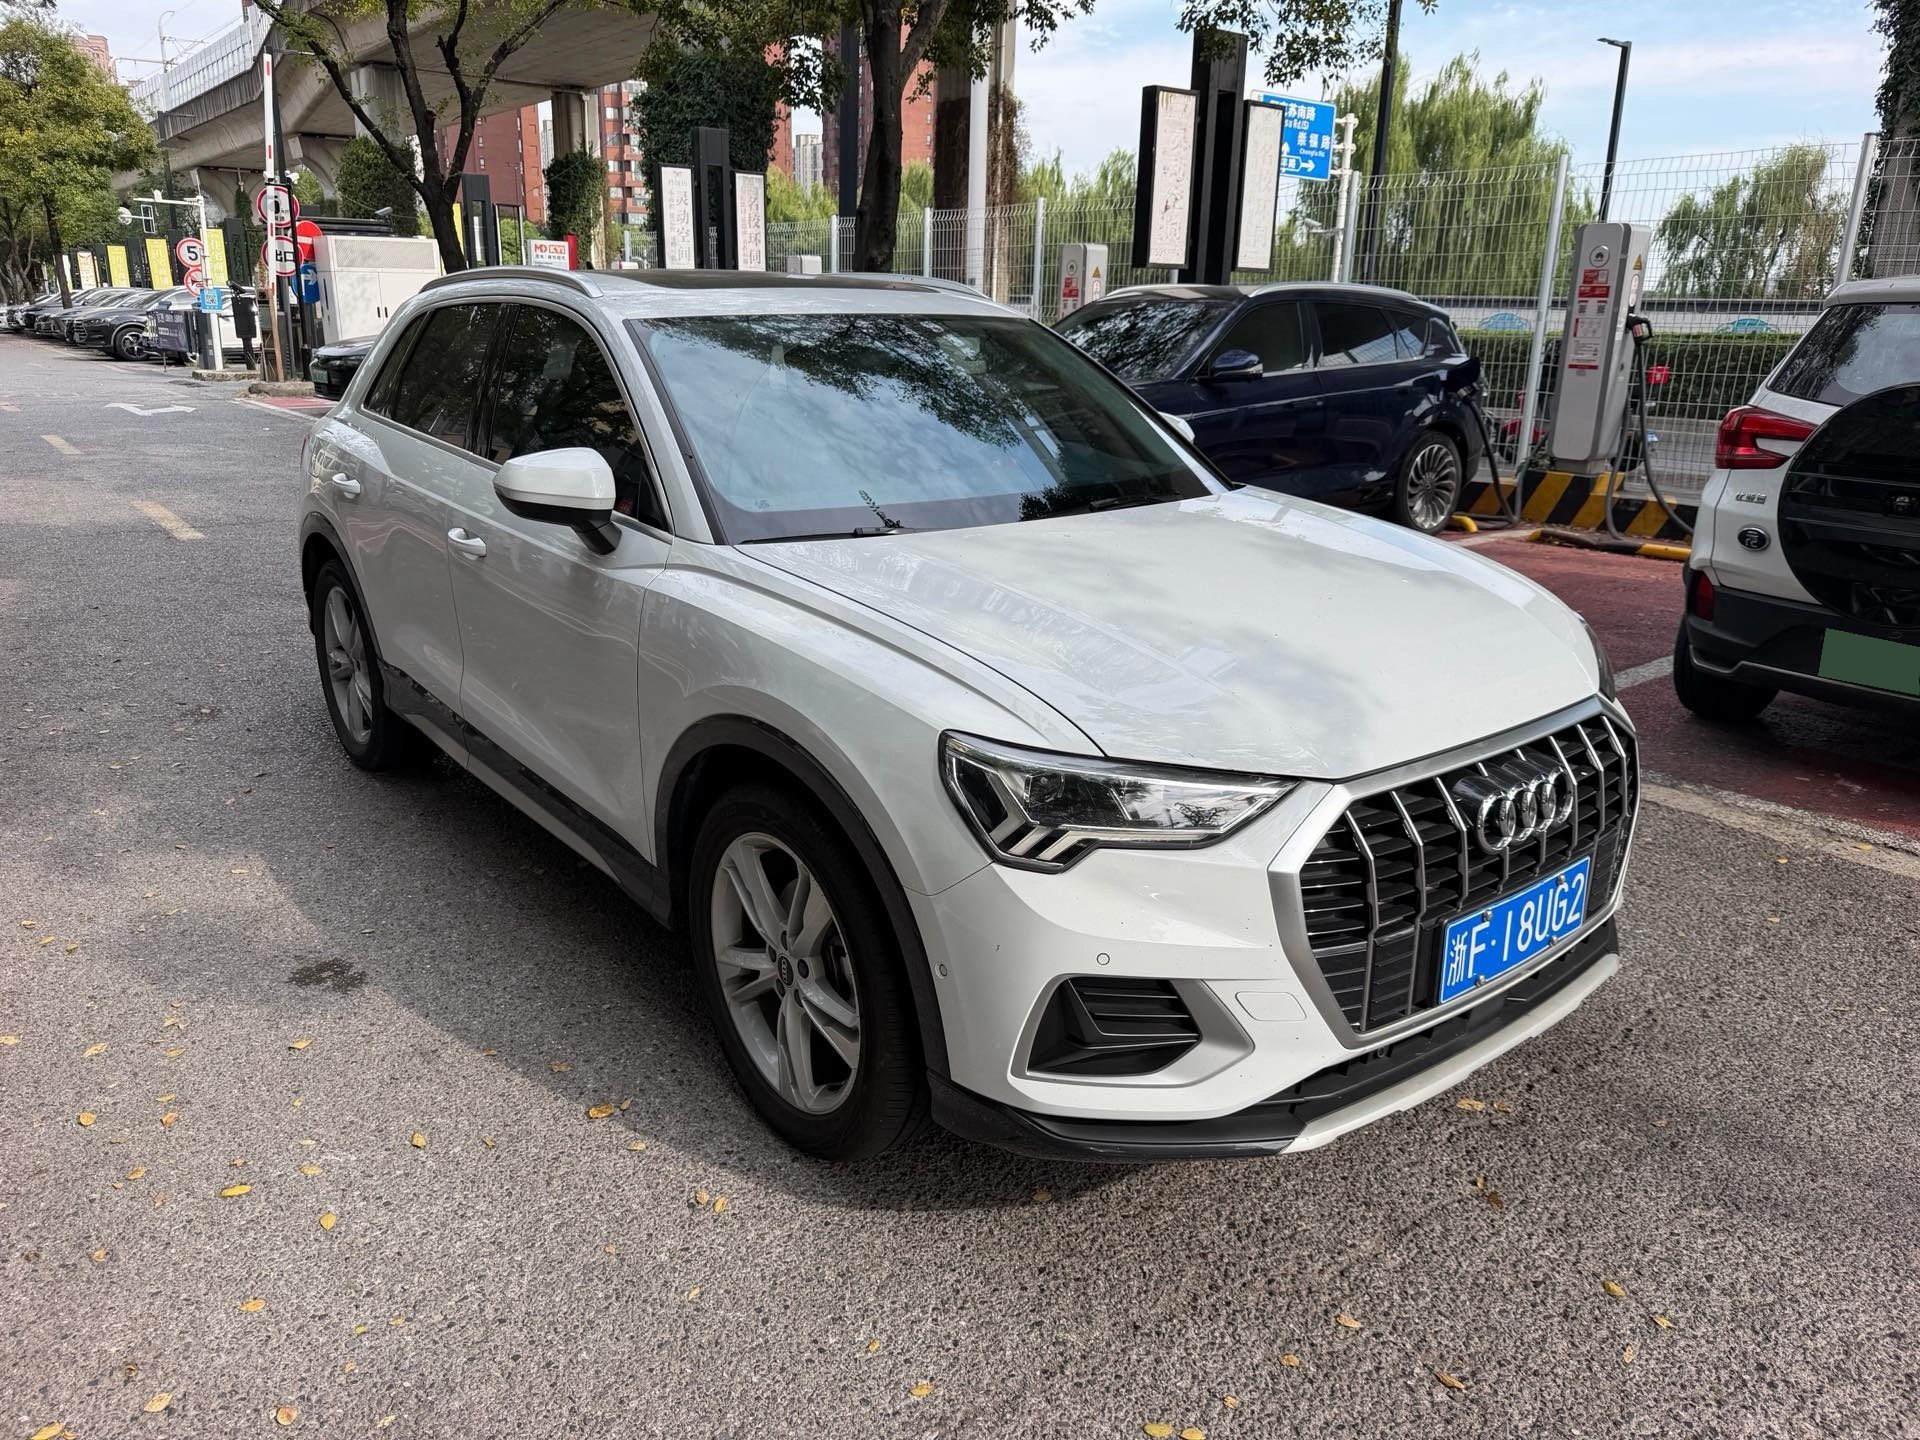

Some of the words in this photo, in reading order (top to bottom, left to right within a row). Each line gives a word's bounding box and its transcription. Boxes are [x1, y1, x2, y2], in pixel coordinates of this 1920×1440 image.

[1297, 131, 1331, 151] 崇福路
[676, 190, 691, 262] 灵动空间
[186, 245, 199, 261] 5
